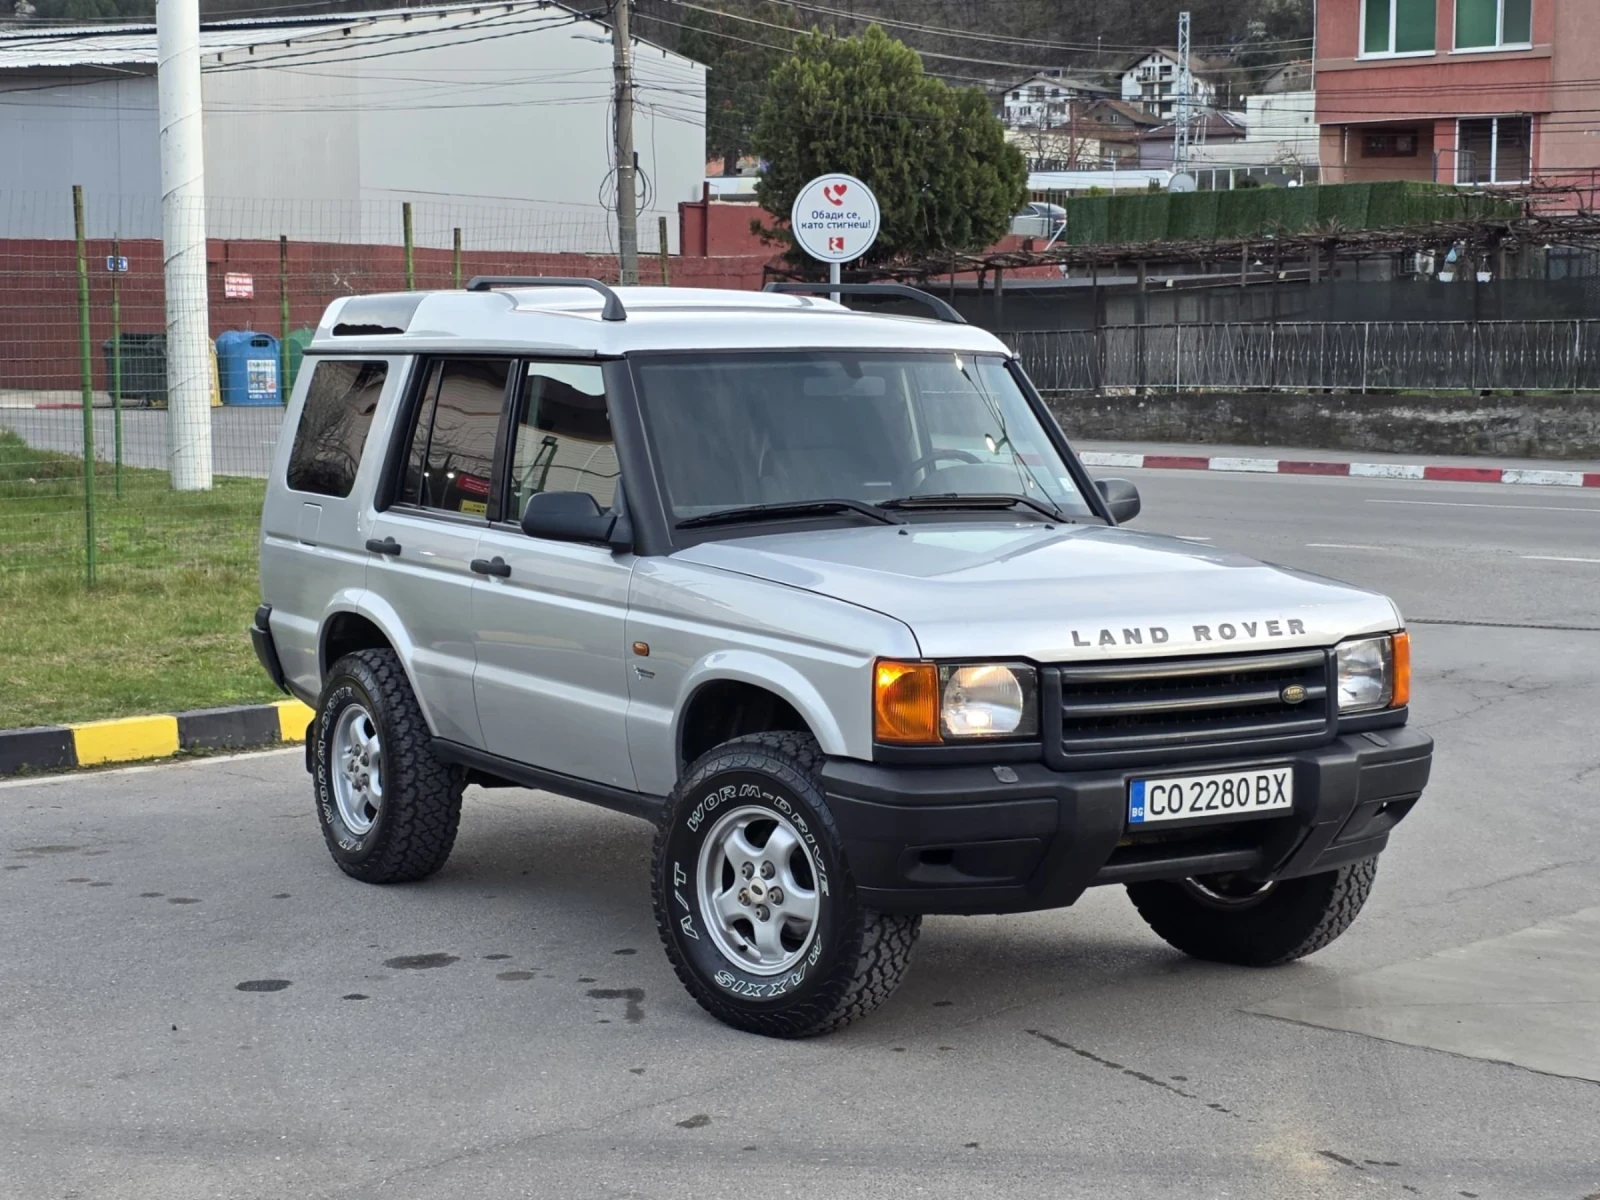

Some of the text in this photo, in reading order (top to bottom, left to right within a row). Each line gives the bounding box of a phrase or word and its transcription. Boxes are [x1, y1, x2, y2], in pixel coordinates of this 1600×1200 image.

[801, 220, 871, 229] като стигнеш!
[811, 209, 861, 220] Обади се,
[1071, 618, 1306, 647] LAND ROVER
[317, 686, 353, 824] WORM-DRIVE
[1188, 777, 1250, 812] 2280
[1131, 807, 1144, 818] BG
[687, 784, 830, 897] WORM-DRIVE
[674, 862, 700, 940] A/T
[714, 933, 822, 998] MAXXIS
